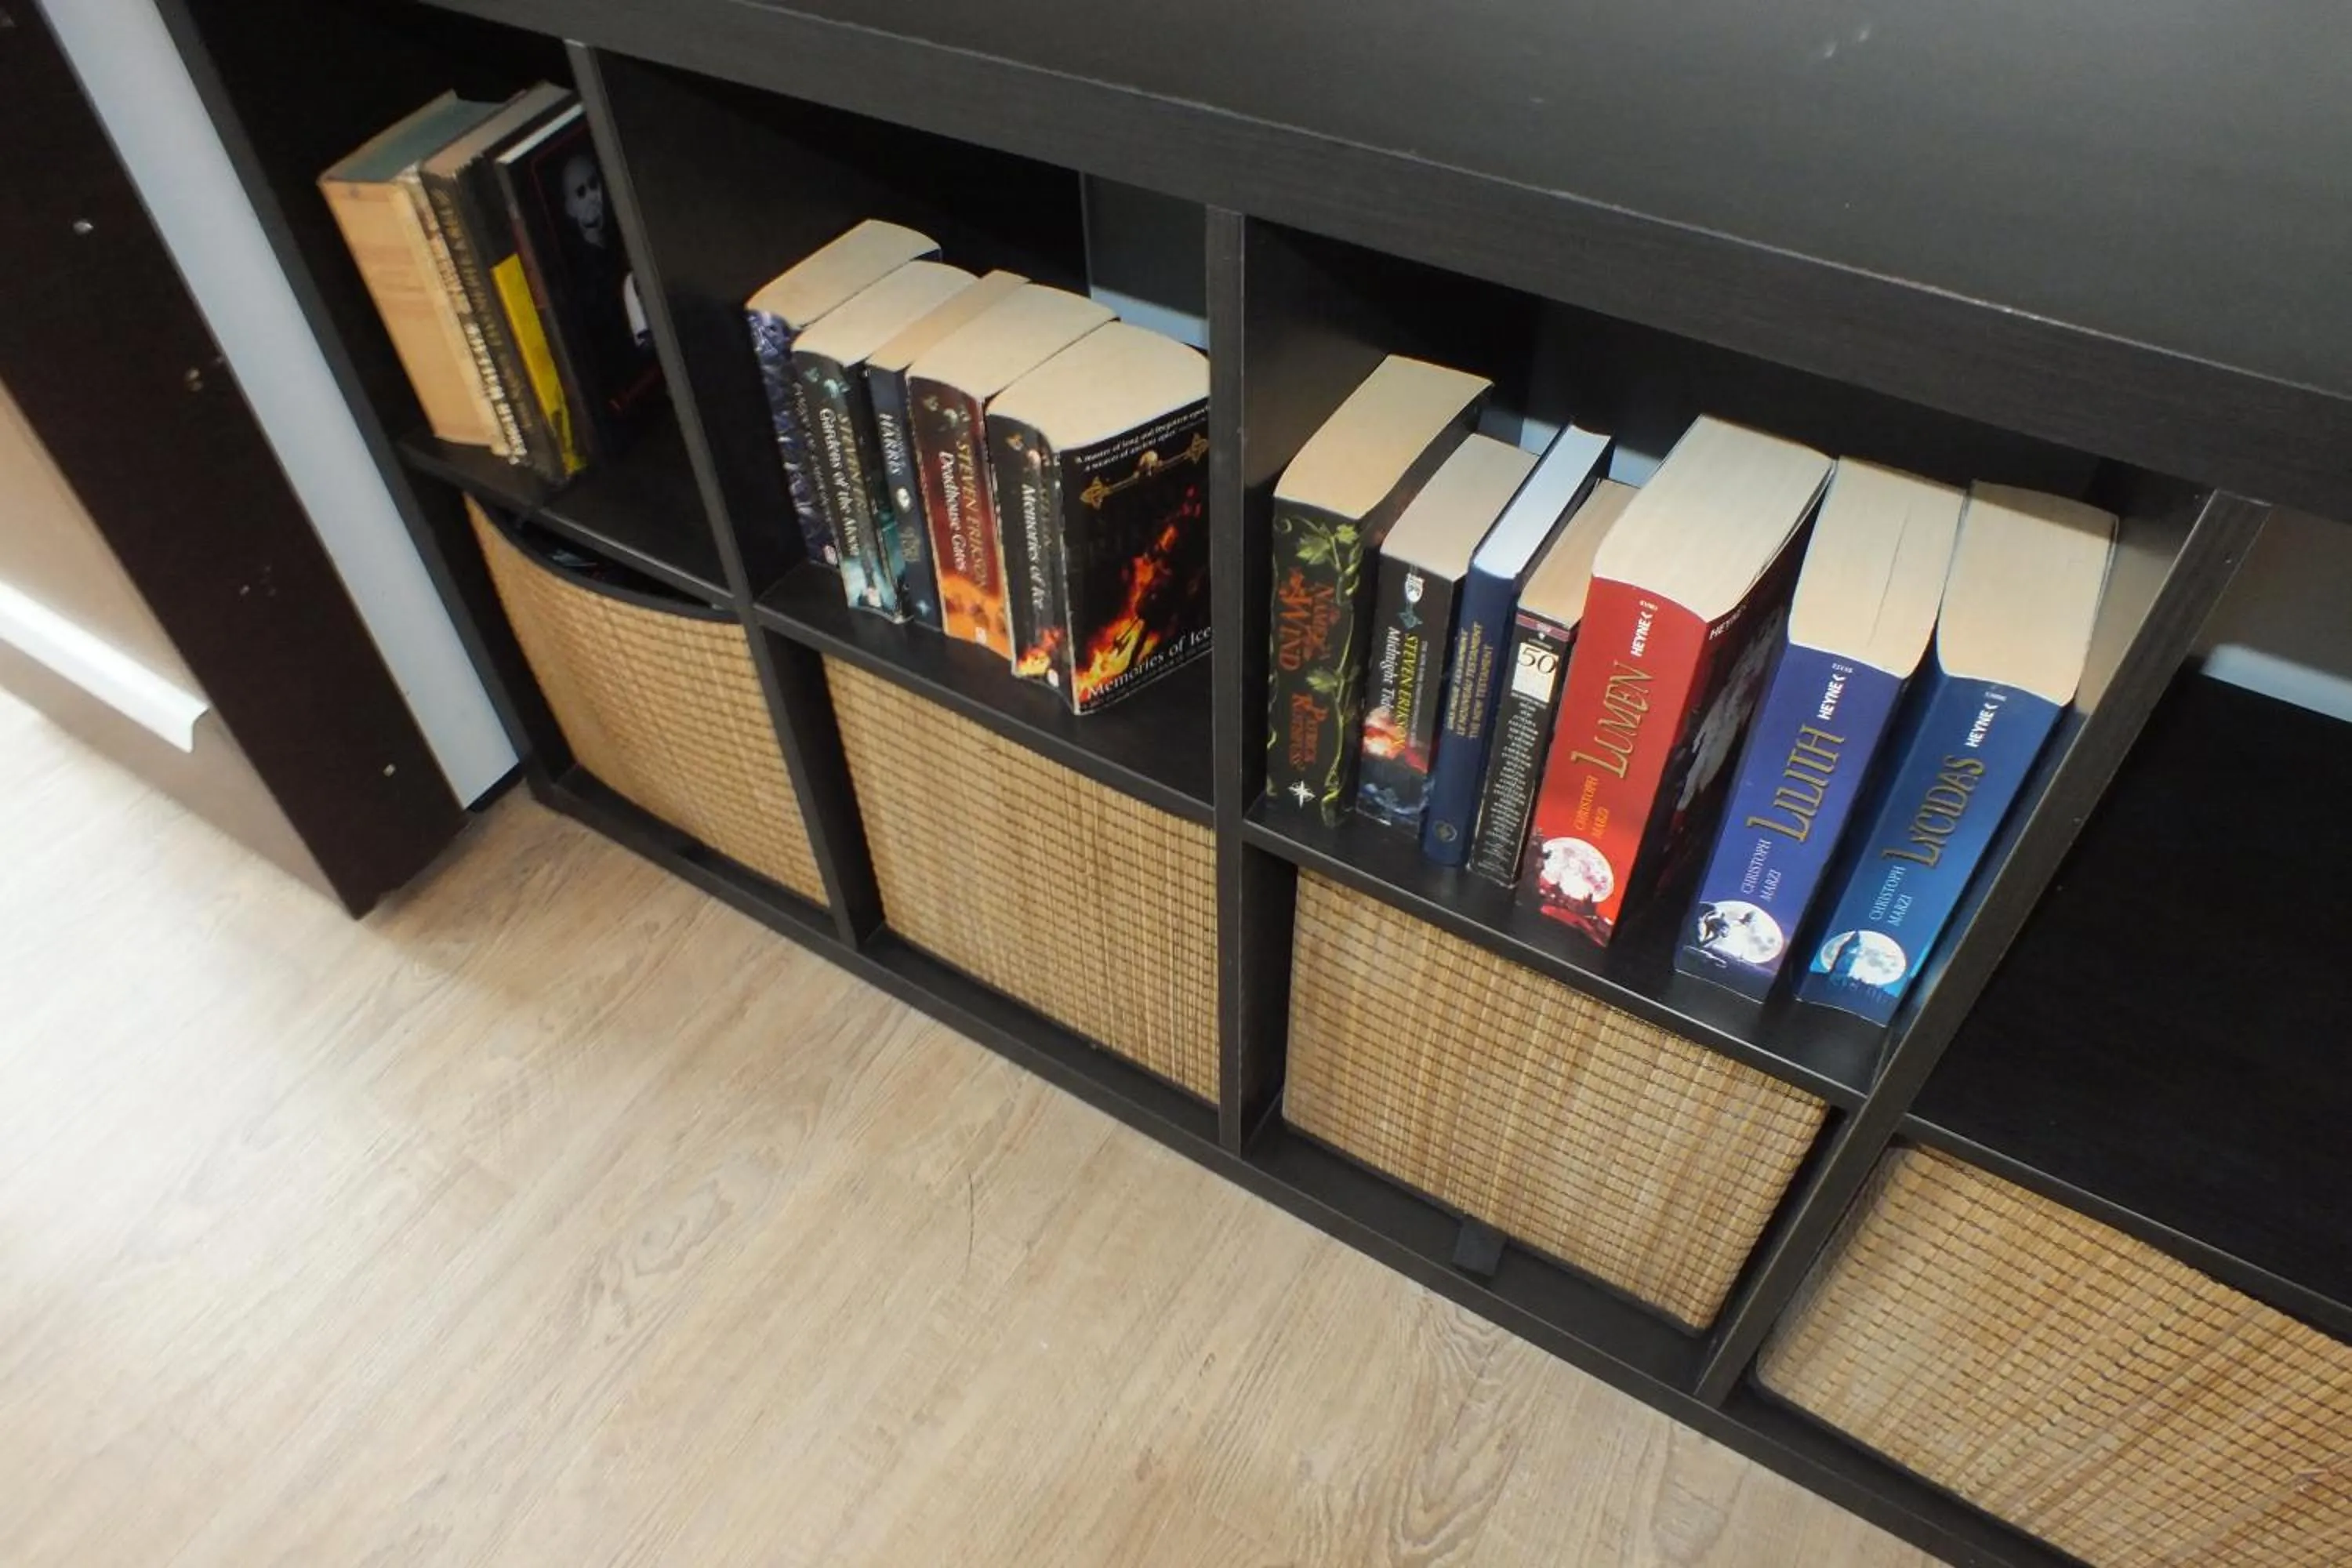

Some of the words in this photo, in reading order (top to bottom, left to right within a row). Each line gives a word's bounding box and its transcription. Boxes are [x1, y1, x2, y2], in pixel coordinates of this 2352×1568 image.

[819, 407, 842, 469] Gardens
[832, 471, 851, 490] of
[878, 412, 902, 475] HARRIS
[956, 440, 978, 510] STEVEN
[939, 451, 962, 532] Deadhouse
[951, 535, 967, 572] Gates
[1022, 483, 1043, 562] Memories
[1029, 564, 1047, 588] of
[1380, 626, 1401, 685] Midnight
[1400, 633, 1419, 688] STEVEN
[1522, 646, 1557, 675] 50
[1629, 616, 1650, 657] HEYNE
[1087, 652, 1165, 700] Memories
[1168, 634, 1186, 657] of
[1389, 688, 1414, 748] ERIKSON
[1570, 659, 1655, 779] LUMEN
[1817, 681, 1844, 720] HEYNE
[1965, 707, 1997, 748] HEYNE
[1746, 724, 1846, 843] LILITH
[1881, 753, 1987, 869] LYCIDAS
[1740, 838, 1773, 895] CHRISTOPH
[1759, 868, 1782, 903] MARZI
[1868, 865, 1907, 922] CHRISTOPH
[1886, 893, 1914, 927] MARZI
